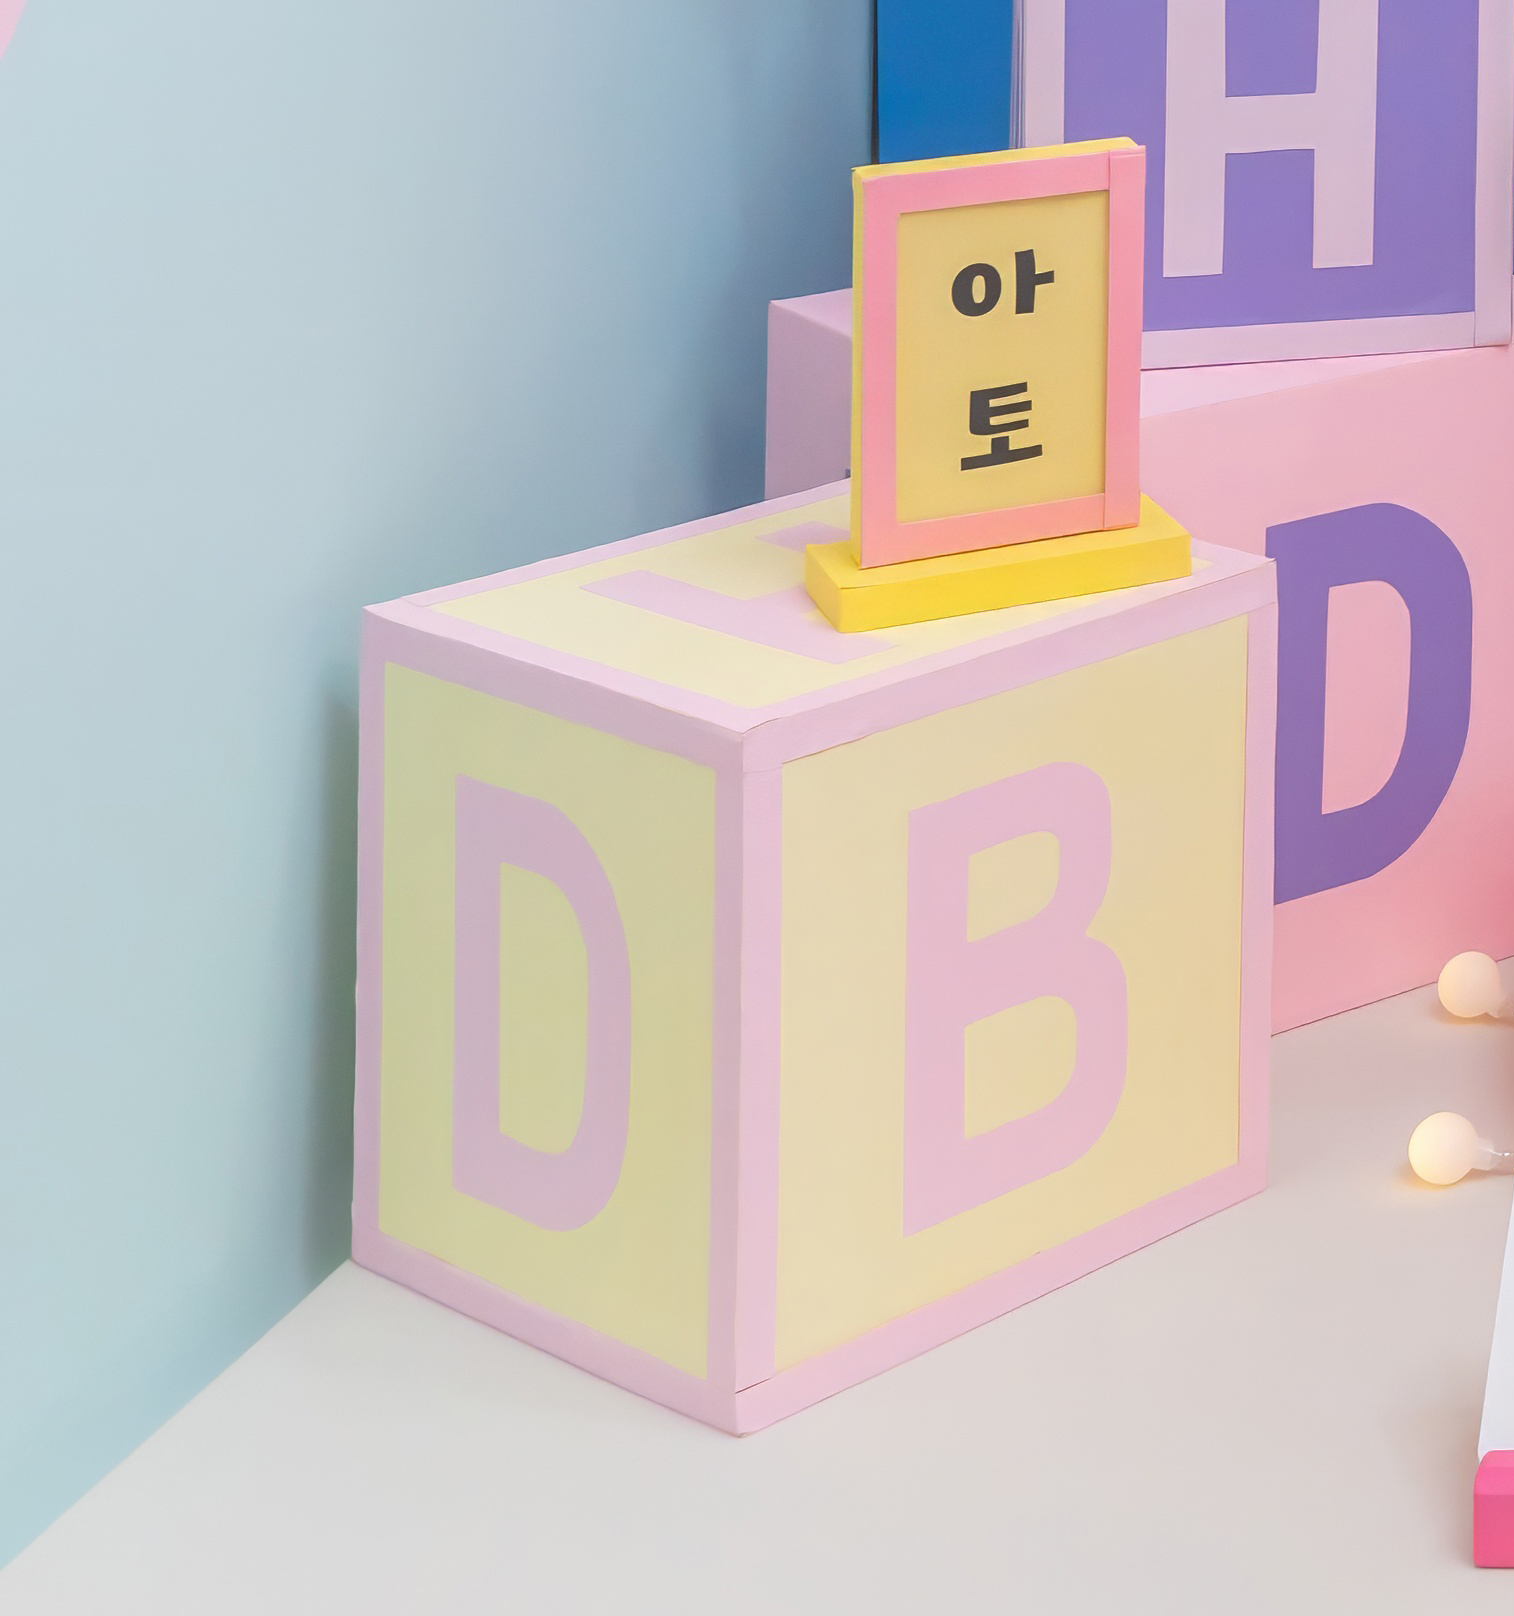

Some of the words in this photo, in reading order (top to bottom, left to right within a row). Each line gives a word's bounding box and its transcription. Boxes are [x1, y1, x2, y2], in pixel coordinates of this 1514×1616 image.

[1265, 502, 1473, 906] D
[451, 772, 632, 1233] D
[903, 761, 1129, 1238] B
